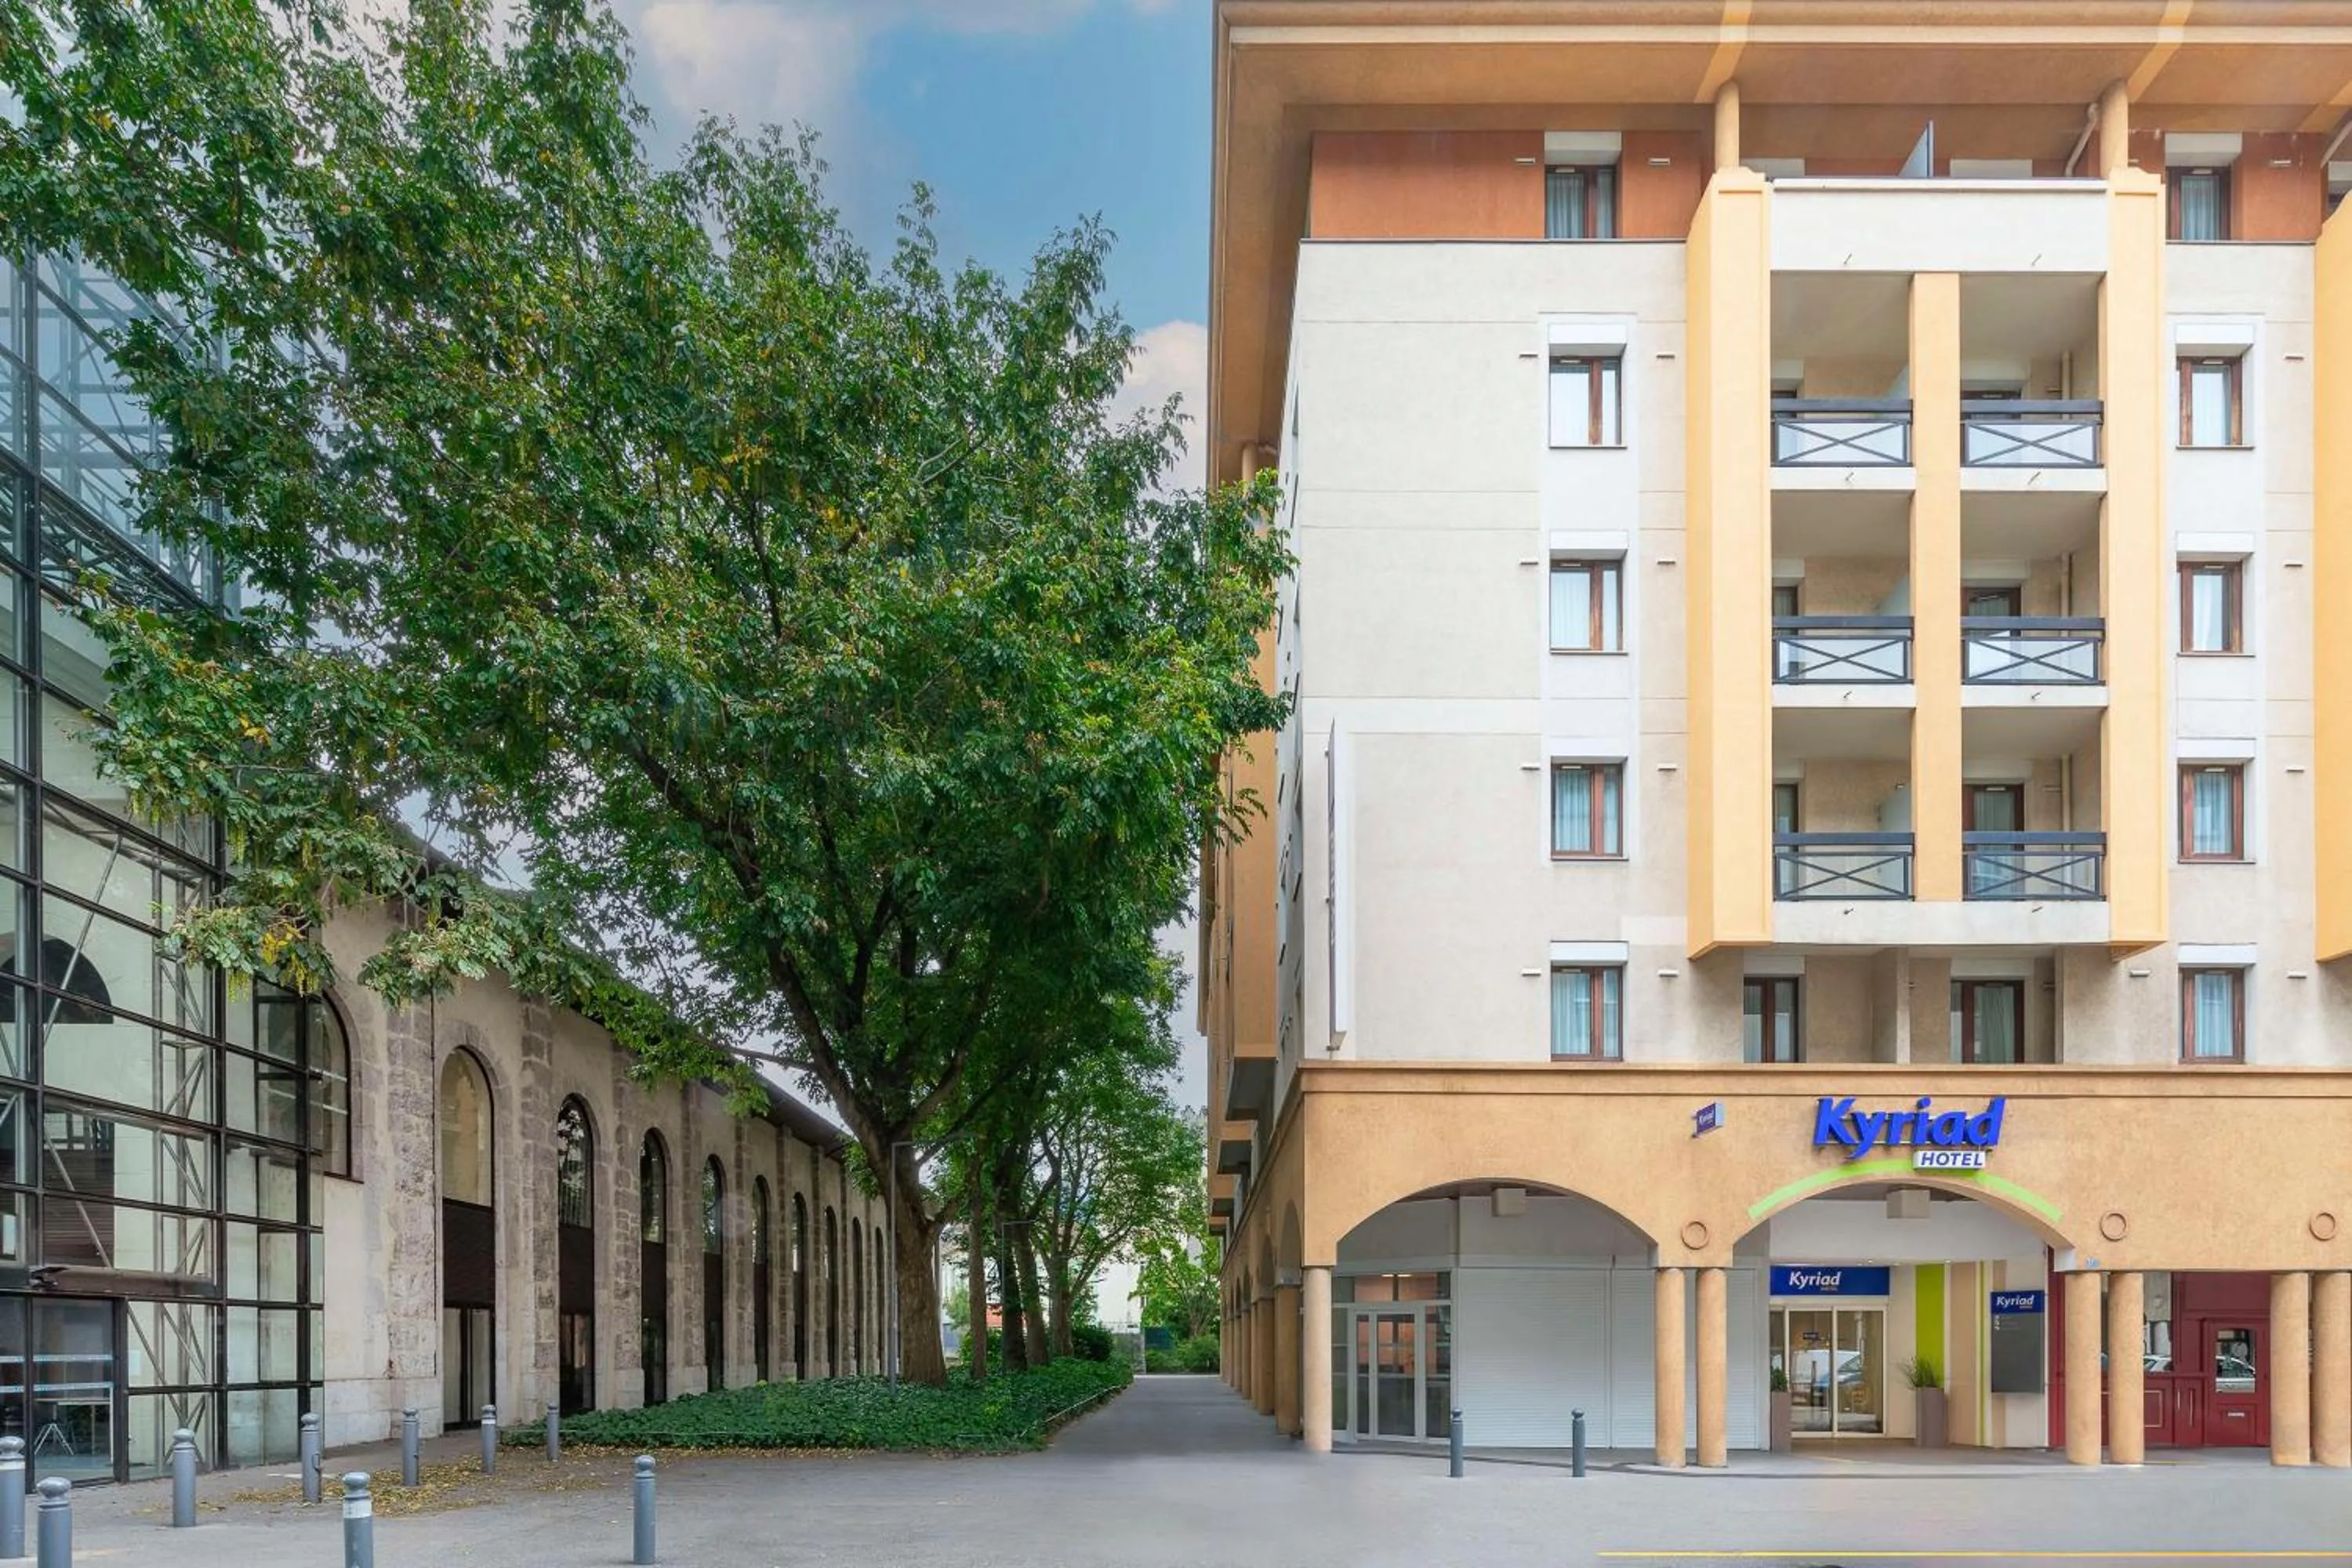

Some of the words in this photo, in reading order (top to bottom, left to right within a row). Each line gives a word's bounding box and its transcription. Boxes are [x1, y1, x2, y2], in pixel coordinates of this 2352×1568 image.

[1813, 1095, 2006, 1160] Kyriad
[1921, 1152, 1983, 1166] HOTEL
[1789, 1271, 1842, 1289] Kyriad
[1996, 1294, 2034, 1308] Kyriad
